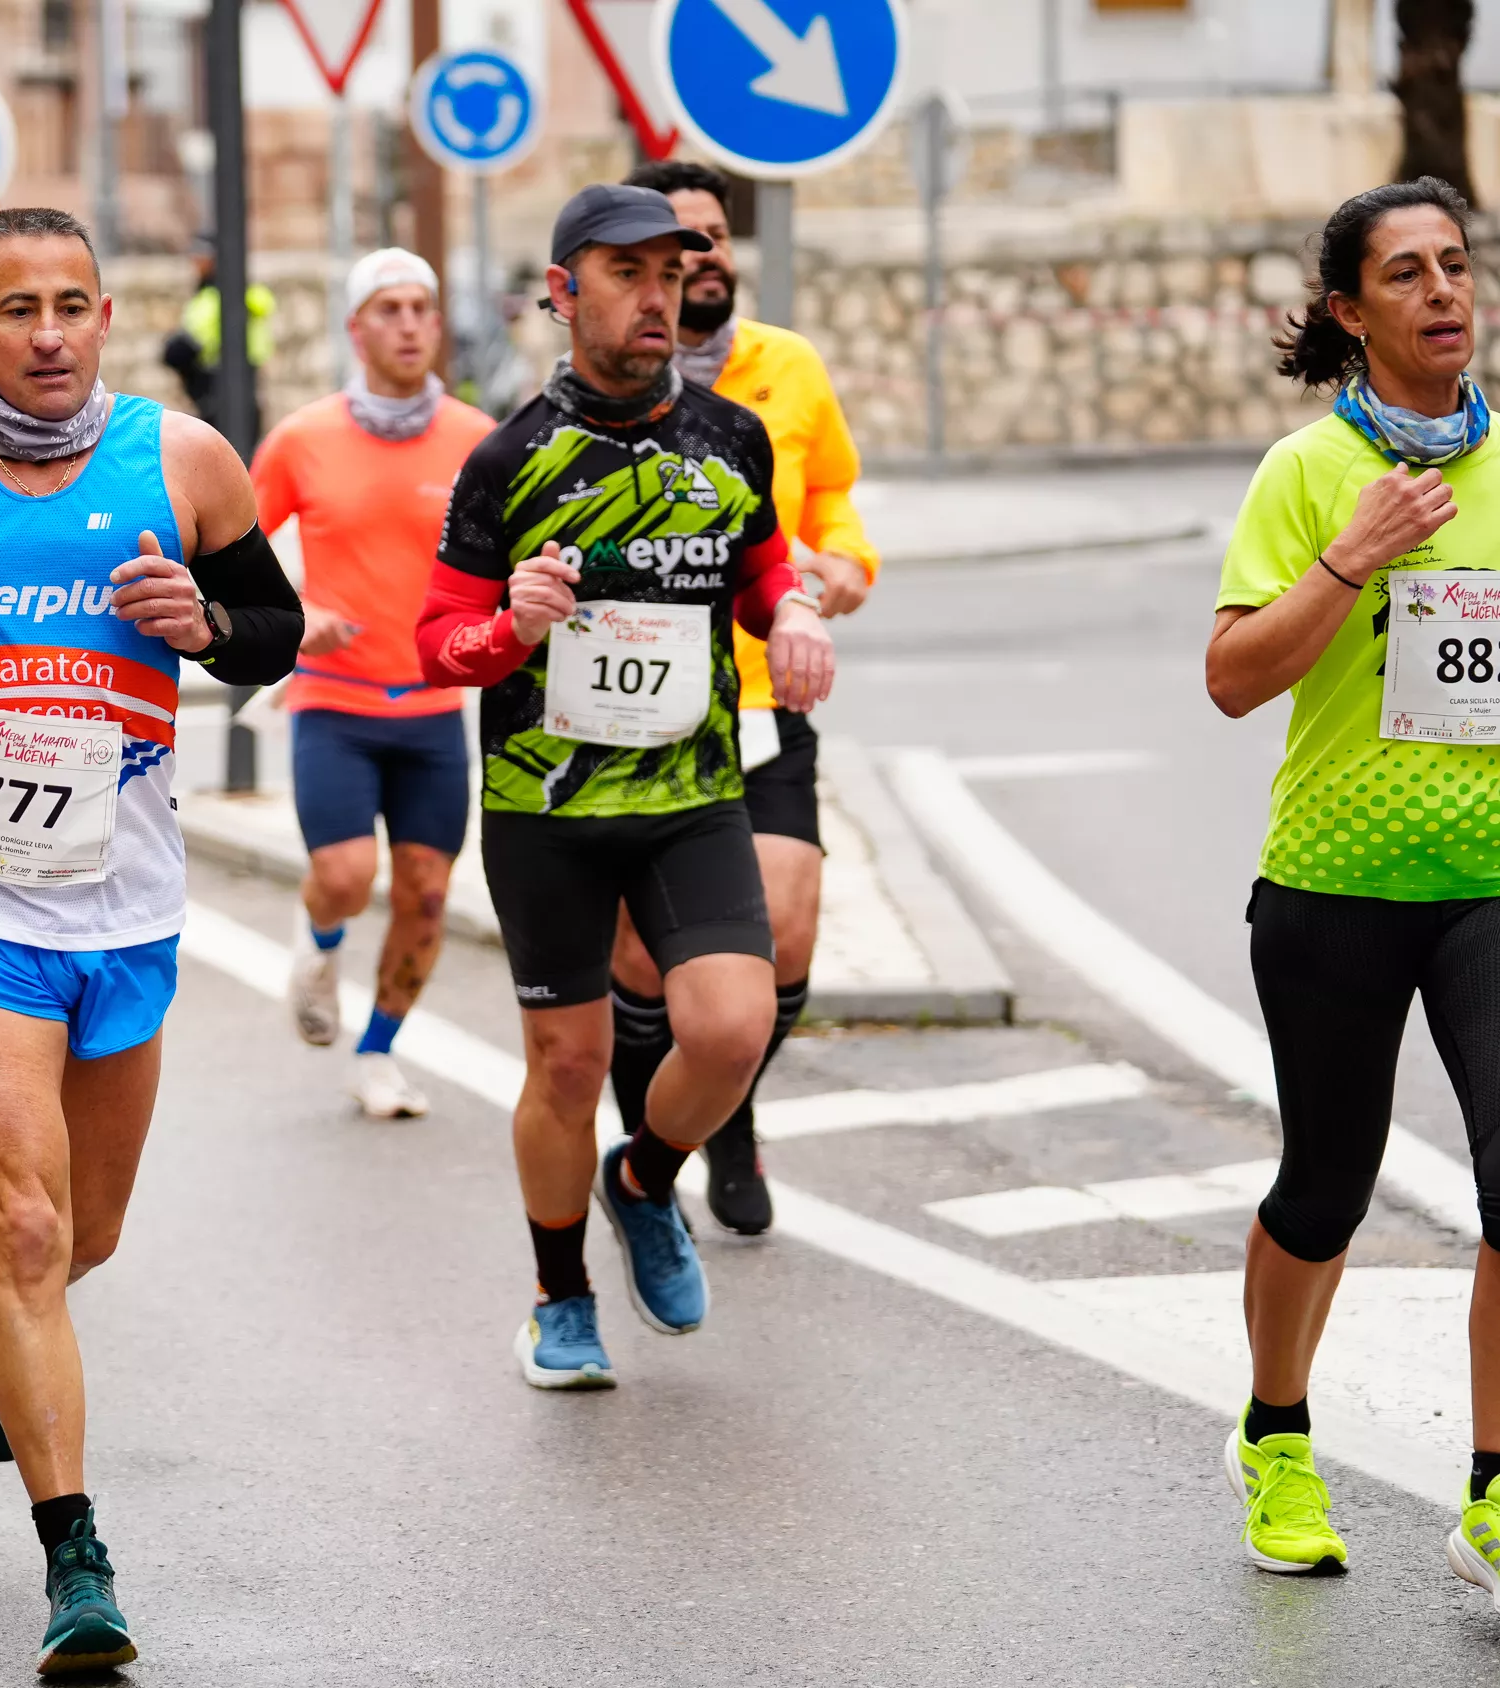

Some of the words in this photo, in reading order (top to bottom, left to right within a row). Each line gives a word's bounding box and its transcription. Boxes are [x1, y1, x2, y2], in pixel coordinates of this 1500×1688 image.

[660, 572, 725, 590] TRAIL
[1461, 602, 1500, 620] LUCEN
[1436, 637, 1500, 684] 88
[591, 653, 671, 696] 107
[1489, 697, 1500, 705] FLO
[32, 731, 78, 750] MARATÓN
[4, 743, 64, 767] LUCENA
[0, 845, 31, 856] L-Hombre
[34, 842, 53, 850] LEIVA
